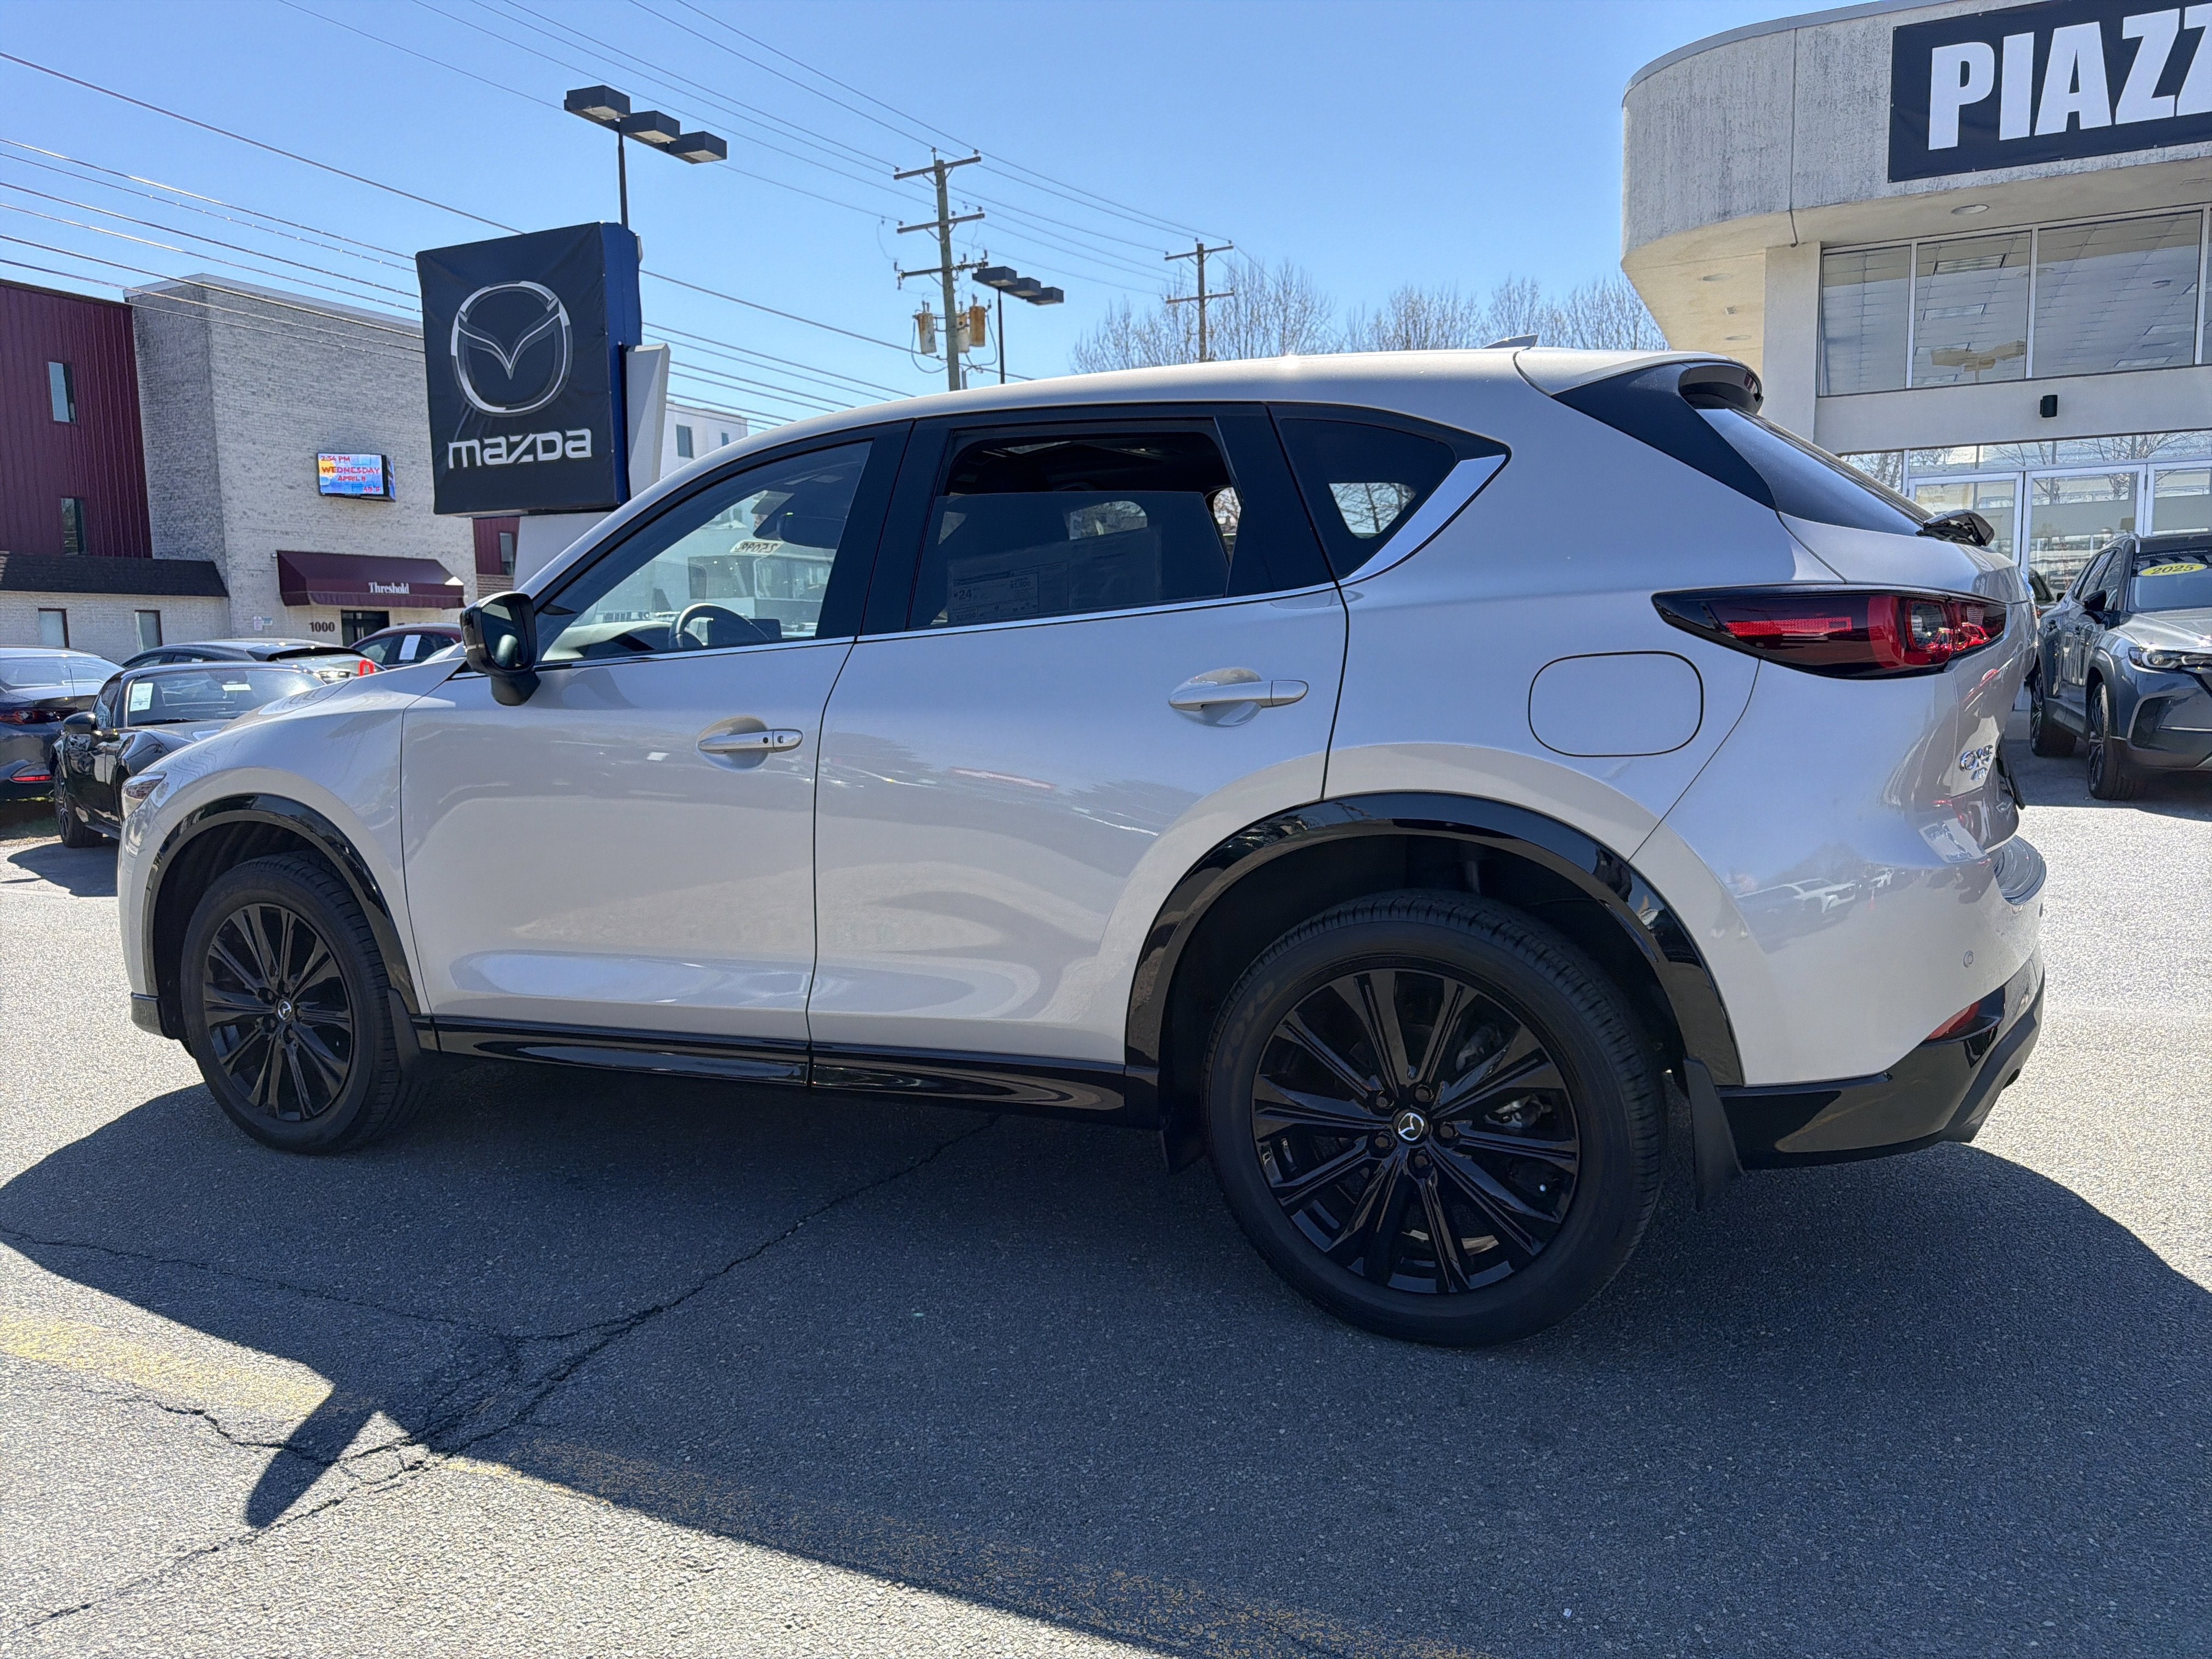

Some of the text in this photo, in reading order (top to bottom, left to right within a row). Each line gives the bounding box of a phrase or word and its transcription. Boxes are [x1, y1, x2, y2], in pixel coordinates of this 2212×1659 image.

[2151, 565, 2196, 574] 2025
[369, 582, 410, 594] Threshold
[959, 589, 972, 600] 24
[309, 622, 335, 633] 1000
